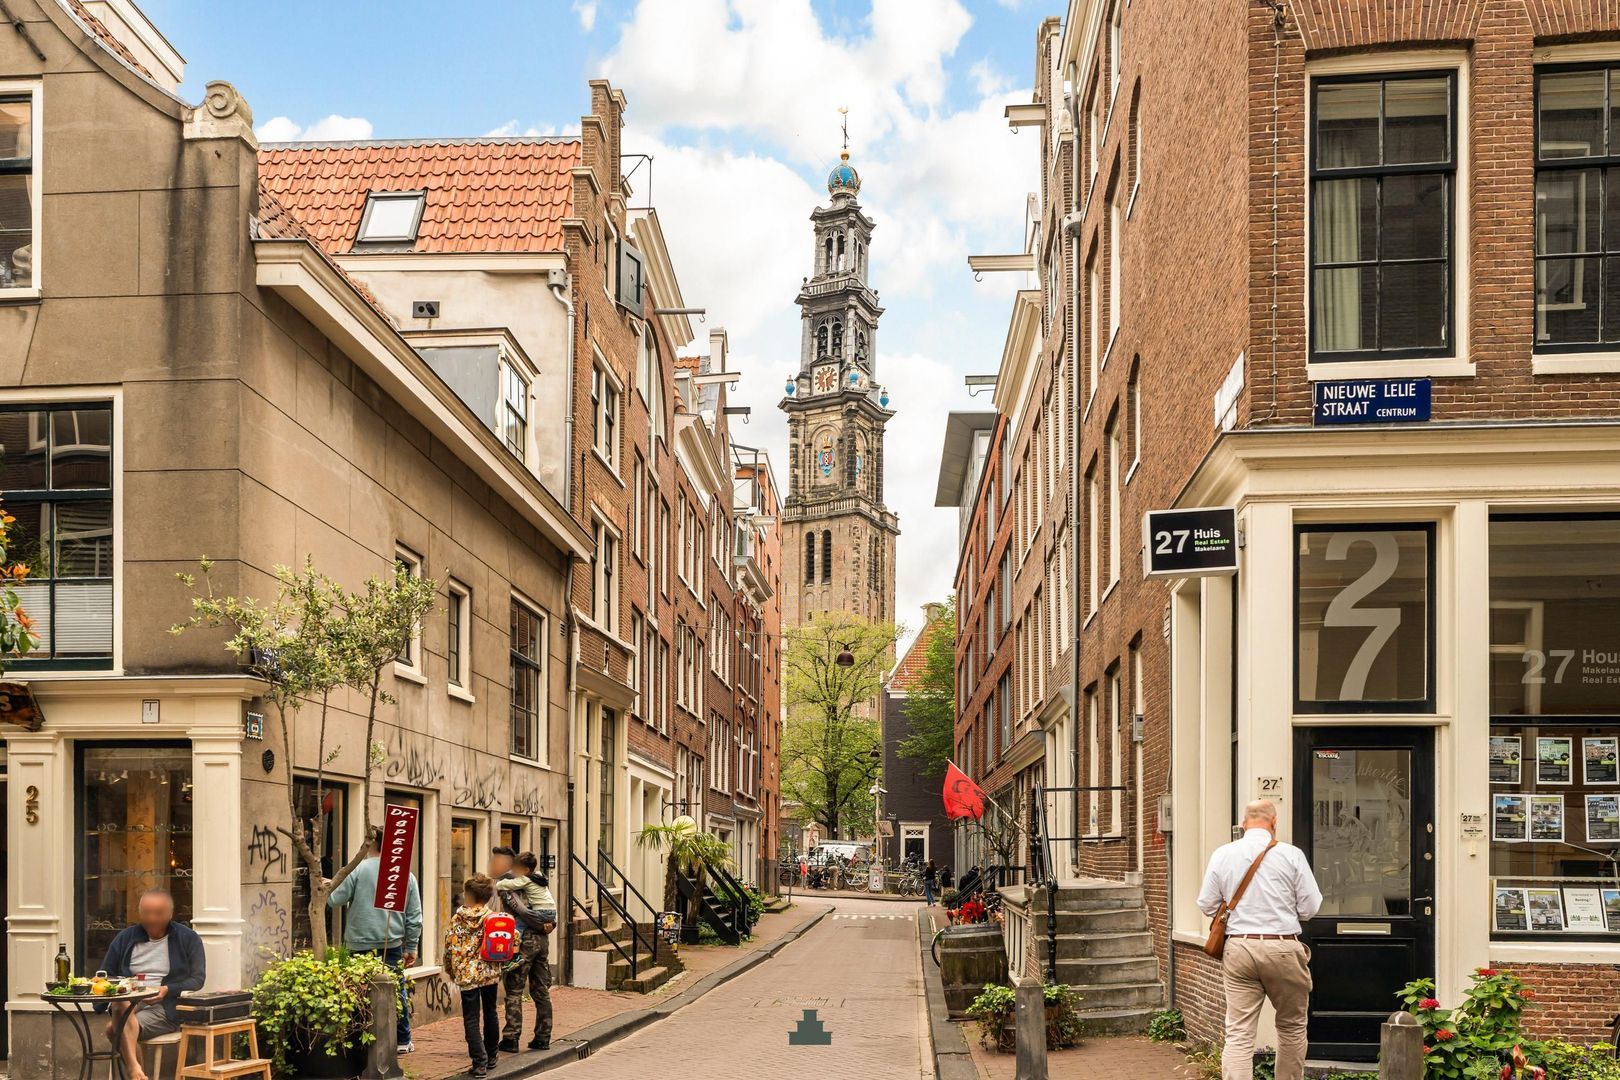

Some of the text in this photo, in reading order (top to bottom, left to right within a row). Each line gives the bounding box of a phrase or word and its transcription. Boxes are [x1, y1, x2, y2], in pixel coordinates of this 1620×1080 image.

[1323, 383, 1416, 400] NIEUWE LELIE
[1322, 401, 1416, 417] STRAAT CENTRUM
[1194, 528, 1221, 539] Huis
[1155, 529, 1190, 555] 27
[1582, 649, 1620, 664] Hou
[1521, 649, 1576, 684] 27
[1582, 676, 1603, 684] Real
[1262, 779, 1279, 790] 27
[26, 785, 39, 827] 25
[390, 808, 414, 819] Dr.
